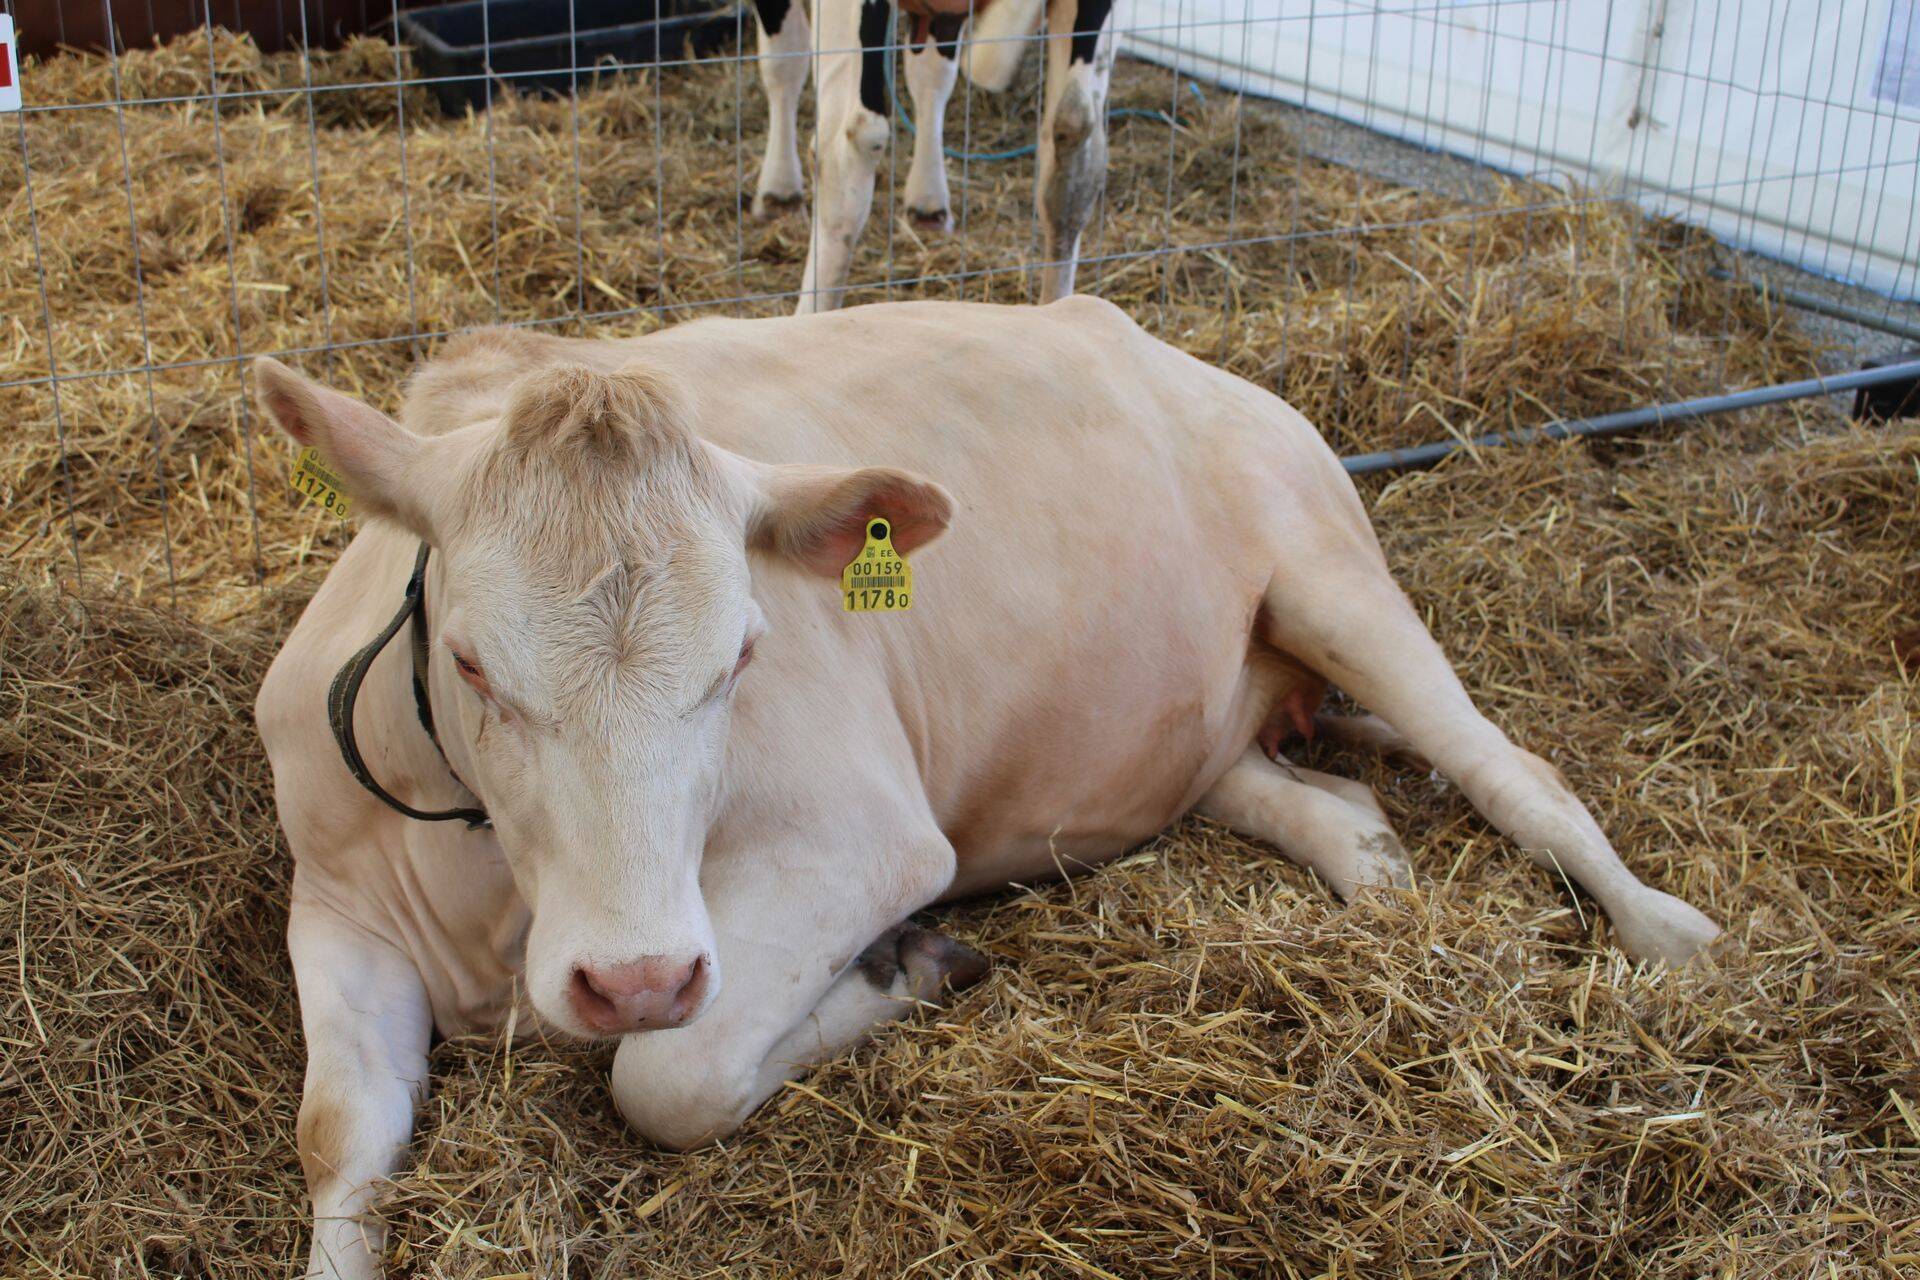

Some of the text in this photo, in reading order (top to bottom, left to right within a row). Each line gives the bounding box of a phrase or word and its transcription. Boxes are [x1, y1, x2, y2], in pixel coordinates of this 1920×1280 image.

[296, 471, 346, 516] 11780
[880, 549, 893, 558] EE
[853, 561, 903, 576] 00159
[847, 588, 909, 610] 11780
